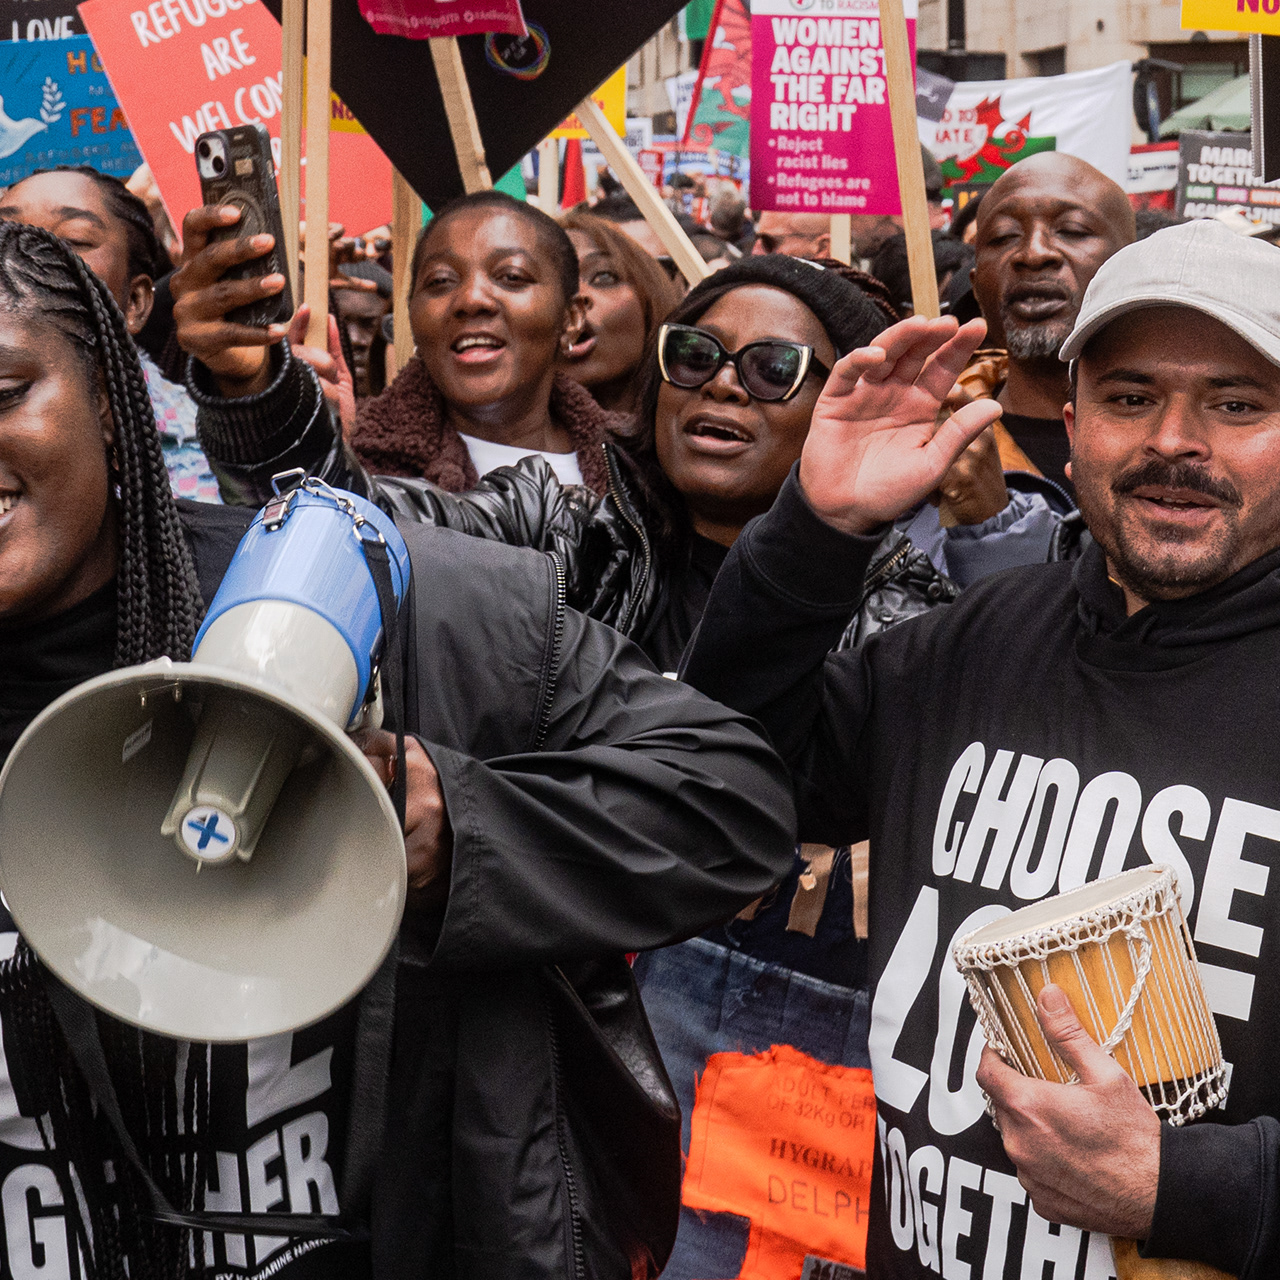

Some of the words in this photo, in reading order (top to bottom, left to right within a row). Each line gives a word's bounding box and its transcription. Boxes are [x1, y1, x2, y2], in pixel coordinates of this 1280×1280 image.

[821, 0, 835, 10] TO
[771, 17, 880, 47] WOMEN
[201, 28, 256, 81] ARE
[770, 74, 826, 102] THE
[831, 76, 885, 104] FAR
[770, 102, 857, 132] RIGHT
[777, 135, 823, 155] Reject
[776, 154, 818, 170] racist
[821, 154, 848, 171] lies
[776, 172, 844, 193] Refugees
[846, 177, 870, 191] are
[776, 192, 800, 206] not
[803, 193, 818, 207] to
[821, 192, 866, 208] blame
